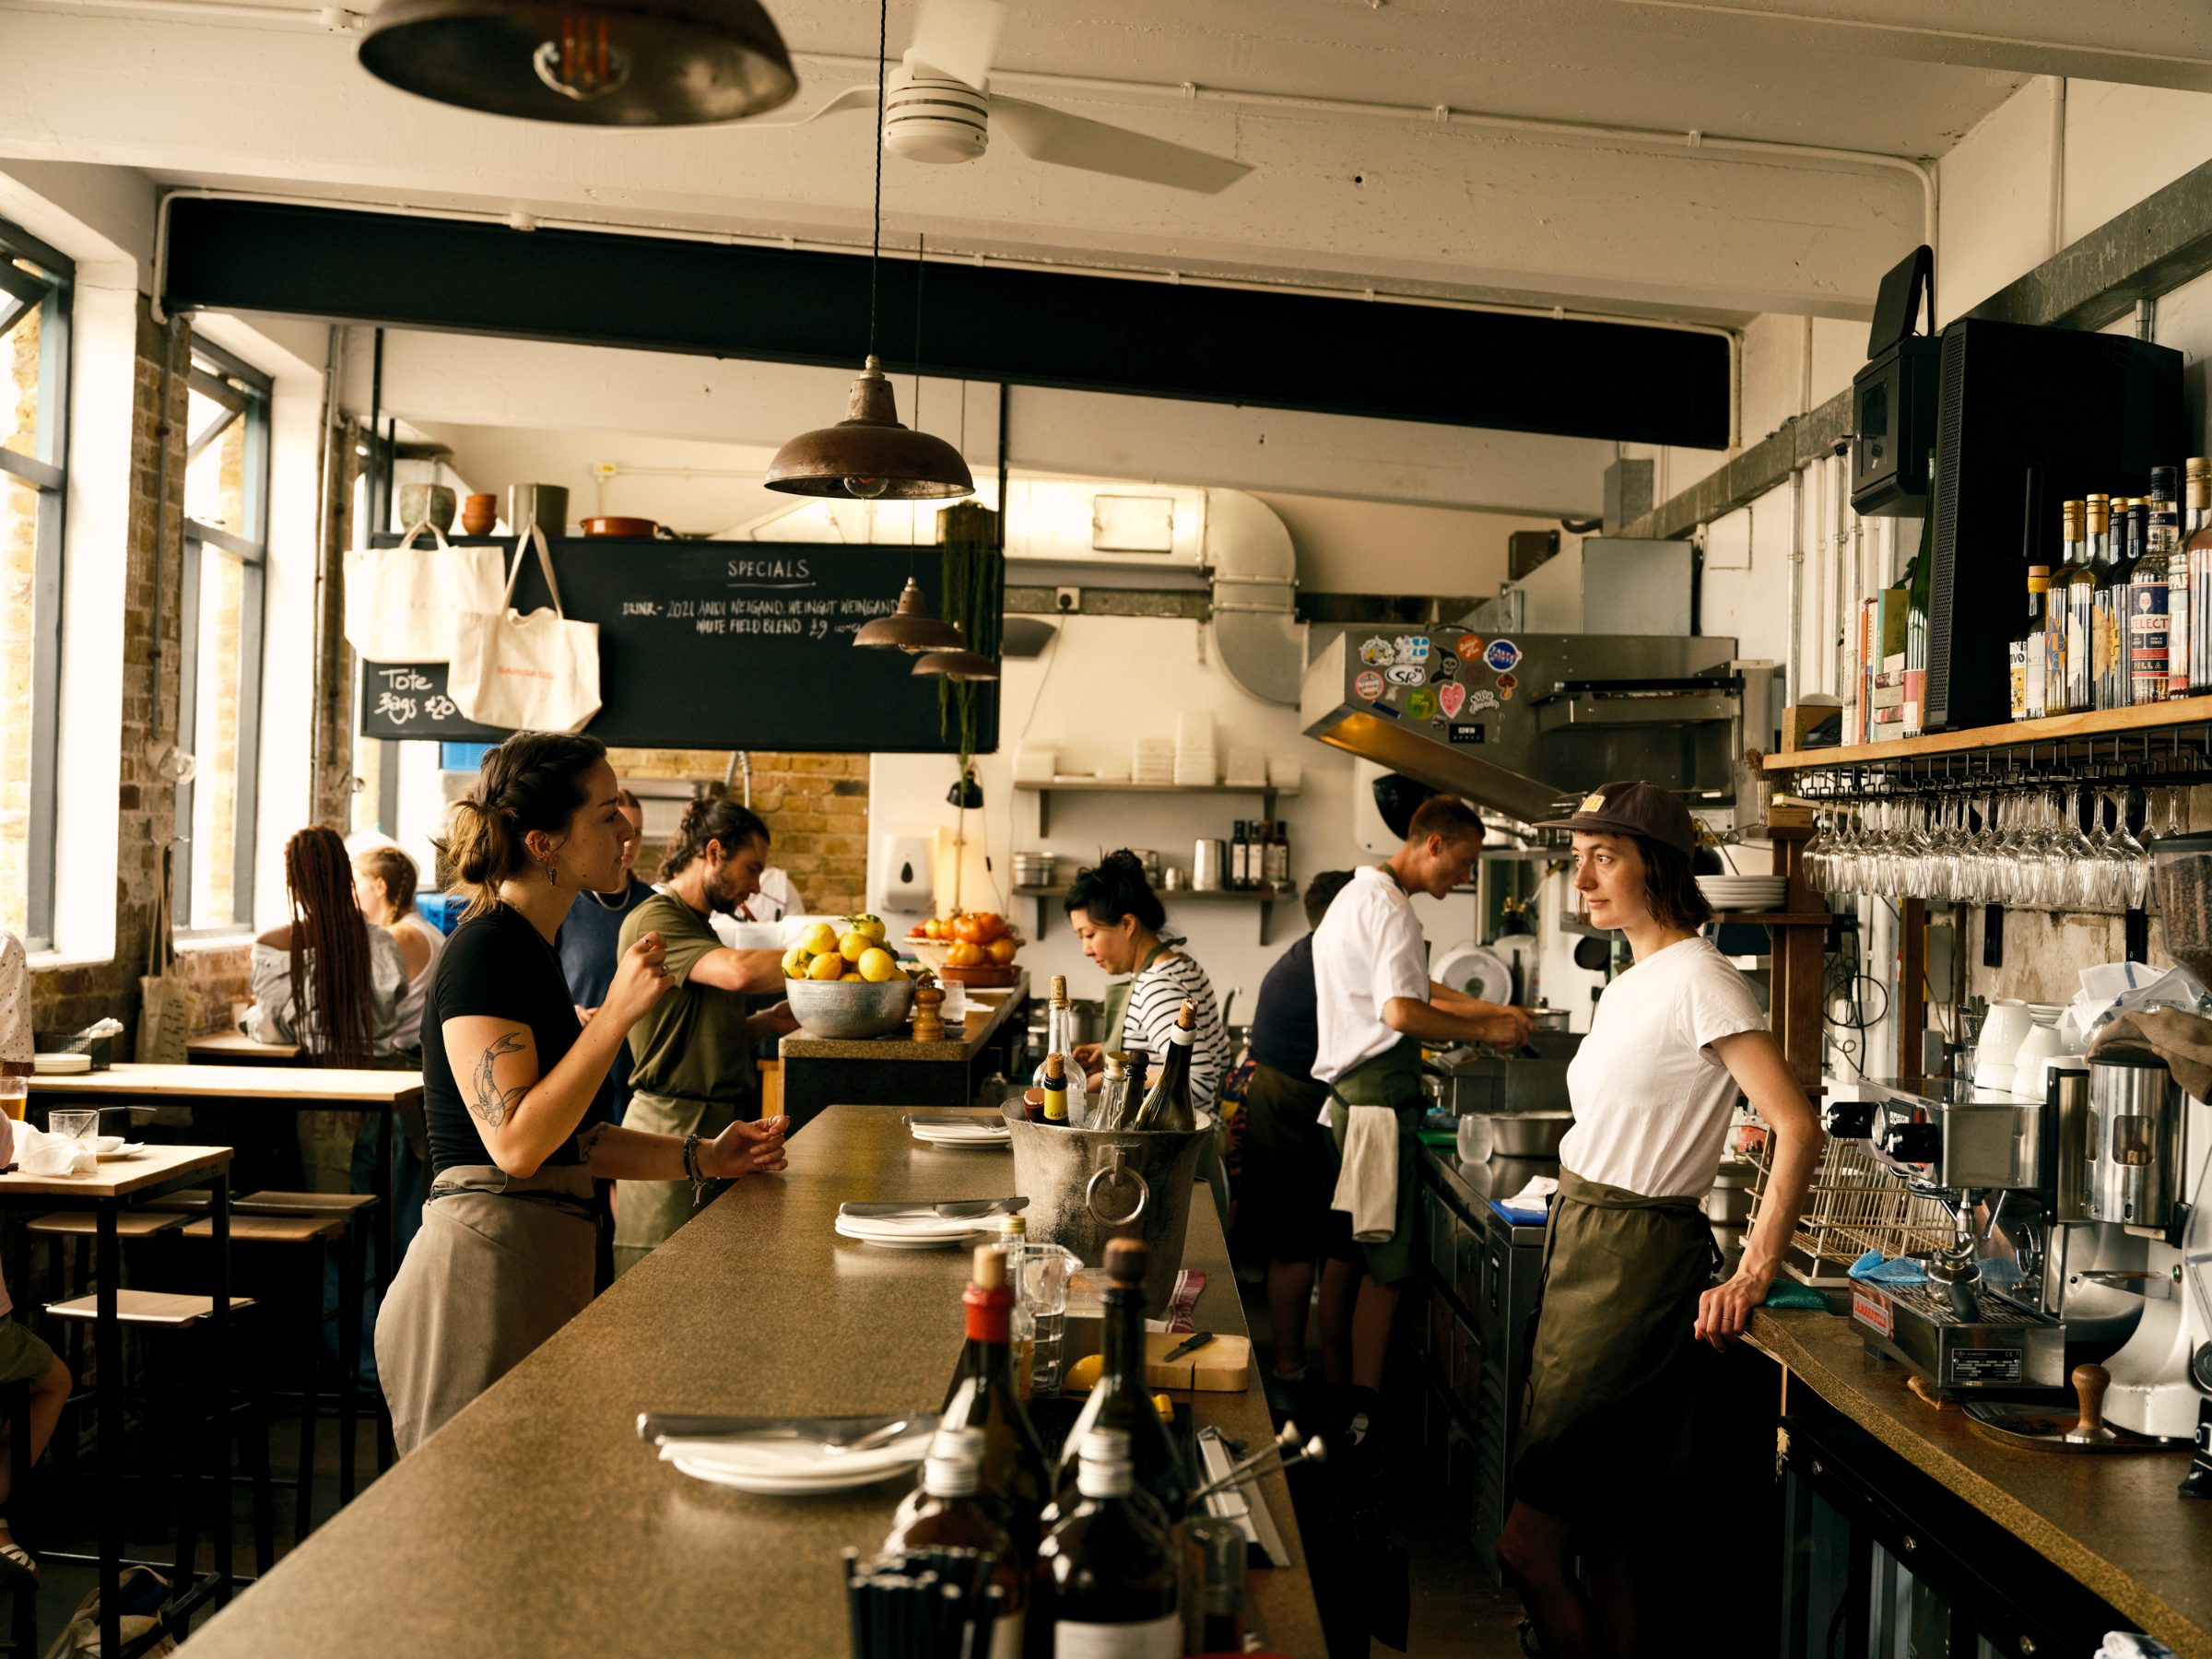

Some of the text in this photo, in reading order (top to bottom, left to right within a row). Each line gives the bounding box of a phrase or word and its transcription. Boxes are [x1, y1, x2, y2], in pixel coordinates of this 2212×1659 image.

[728, 559, 809, 578] SPECIALS
[763, 618, 802, 635] BLEND
[379, 667, 433, 690] Tote
[374, 691, 418, 725] Bags
